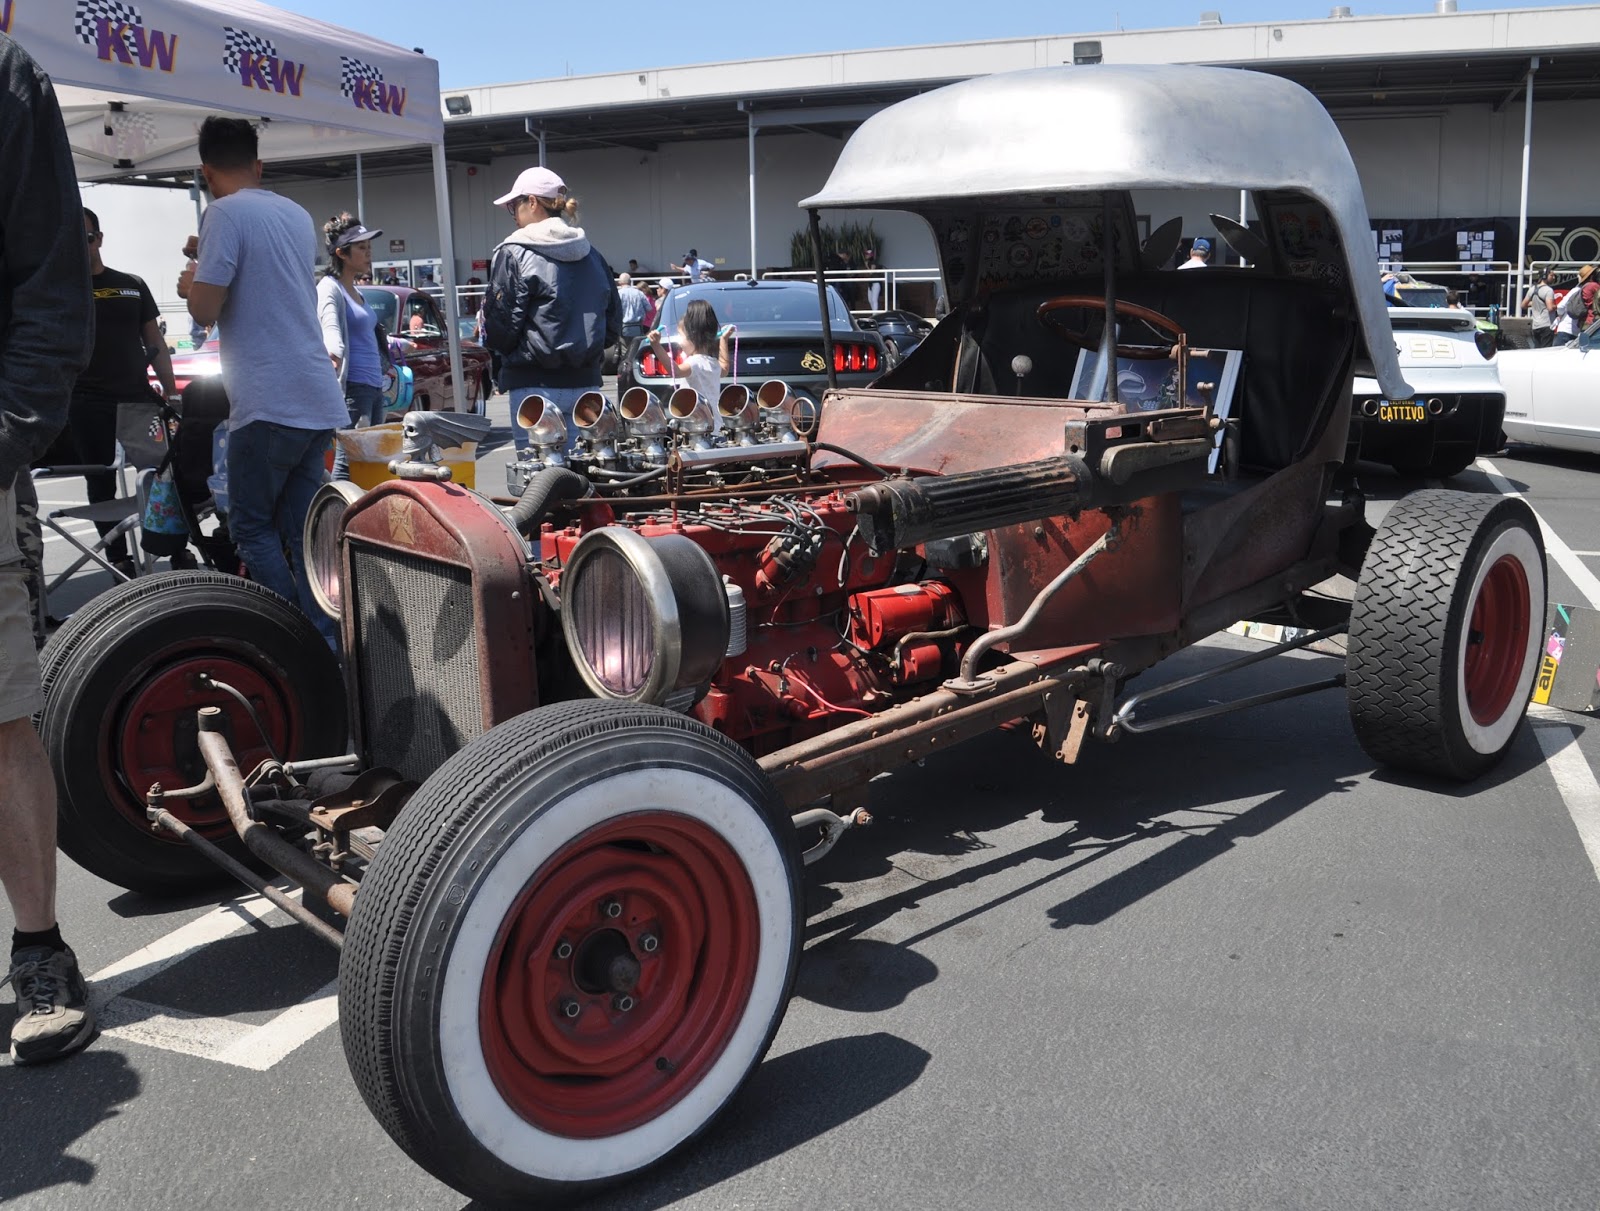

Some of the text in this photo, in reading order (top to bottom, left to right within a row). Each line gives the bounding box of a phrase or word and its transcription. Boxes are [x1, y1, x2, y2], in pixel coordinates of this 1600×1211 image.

[96, 17, 178, 73] KW
[239, 50, 305, 98] KW
[353, 76, 408, 117] KW
[1525, 227, 1600, 280] 50
[746, 356, 775, 365] GT
[1380, 406, 1424, 420] CATTIVO
[1539, 658, 1555, 691] air
